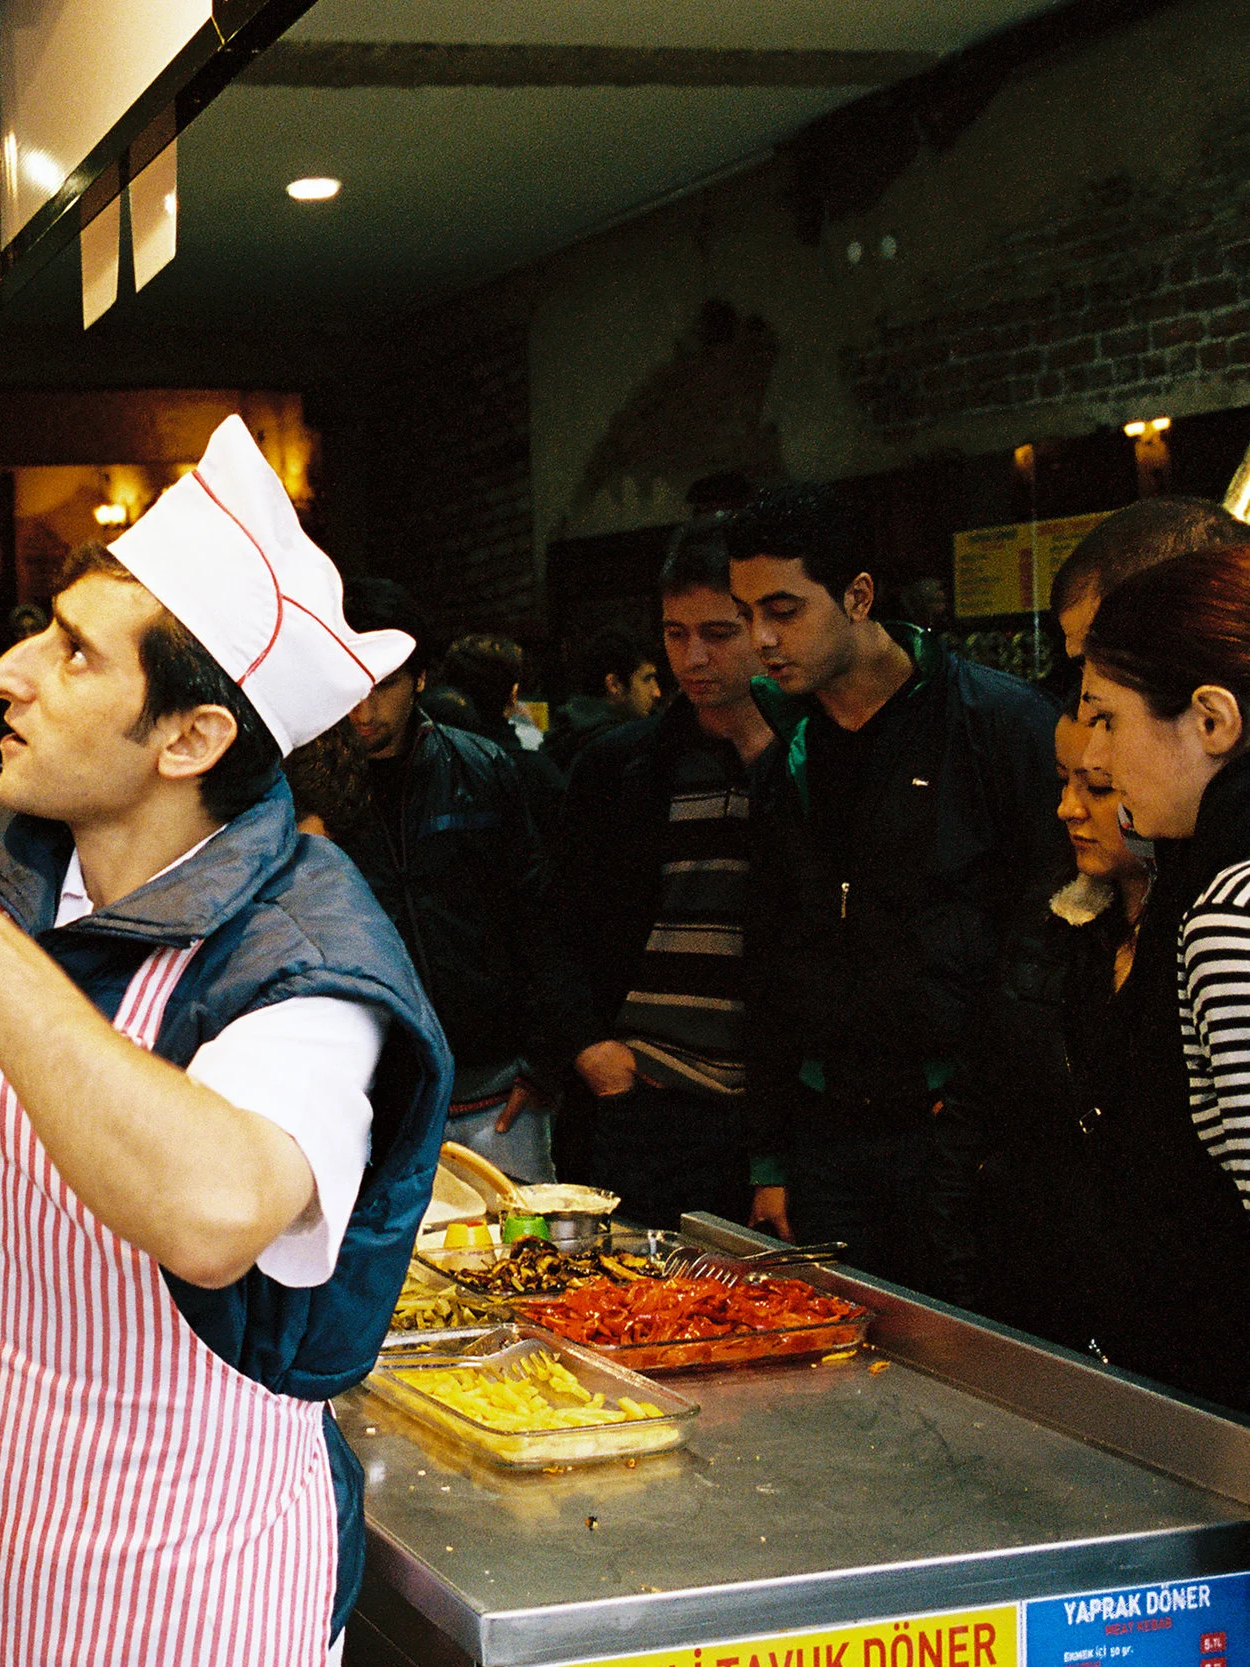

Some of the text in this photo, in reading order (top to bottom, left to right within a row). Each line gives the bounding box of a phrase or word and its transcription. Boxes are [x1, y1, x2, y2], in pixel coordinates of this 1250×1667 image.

[1064, 1583, 1211, 1625] YAPRAK DÖNER
[863, 1621, 997, 1667] DÖNER
[1105, 1617, 1172, 1636] MEAT KEBAB
